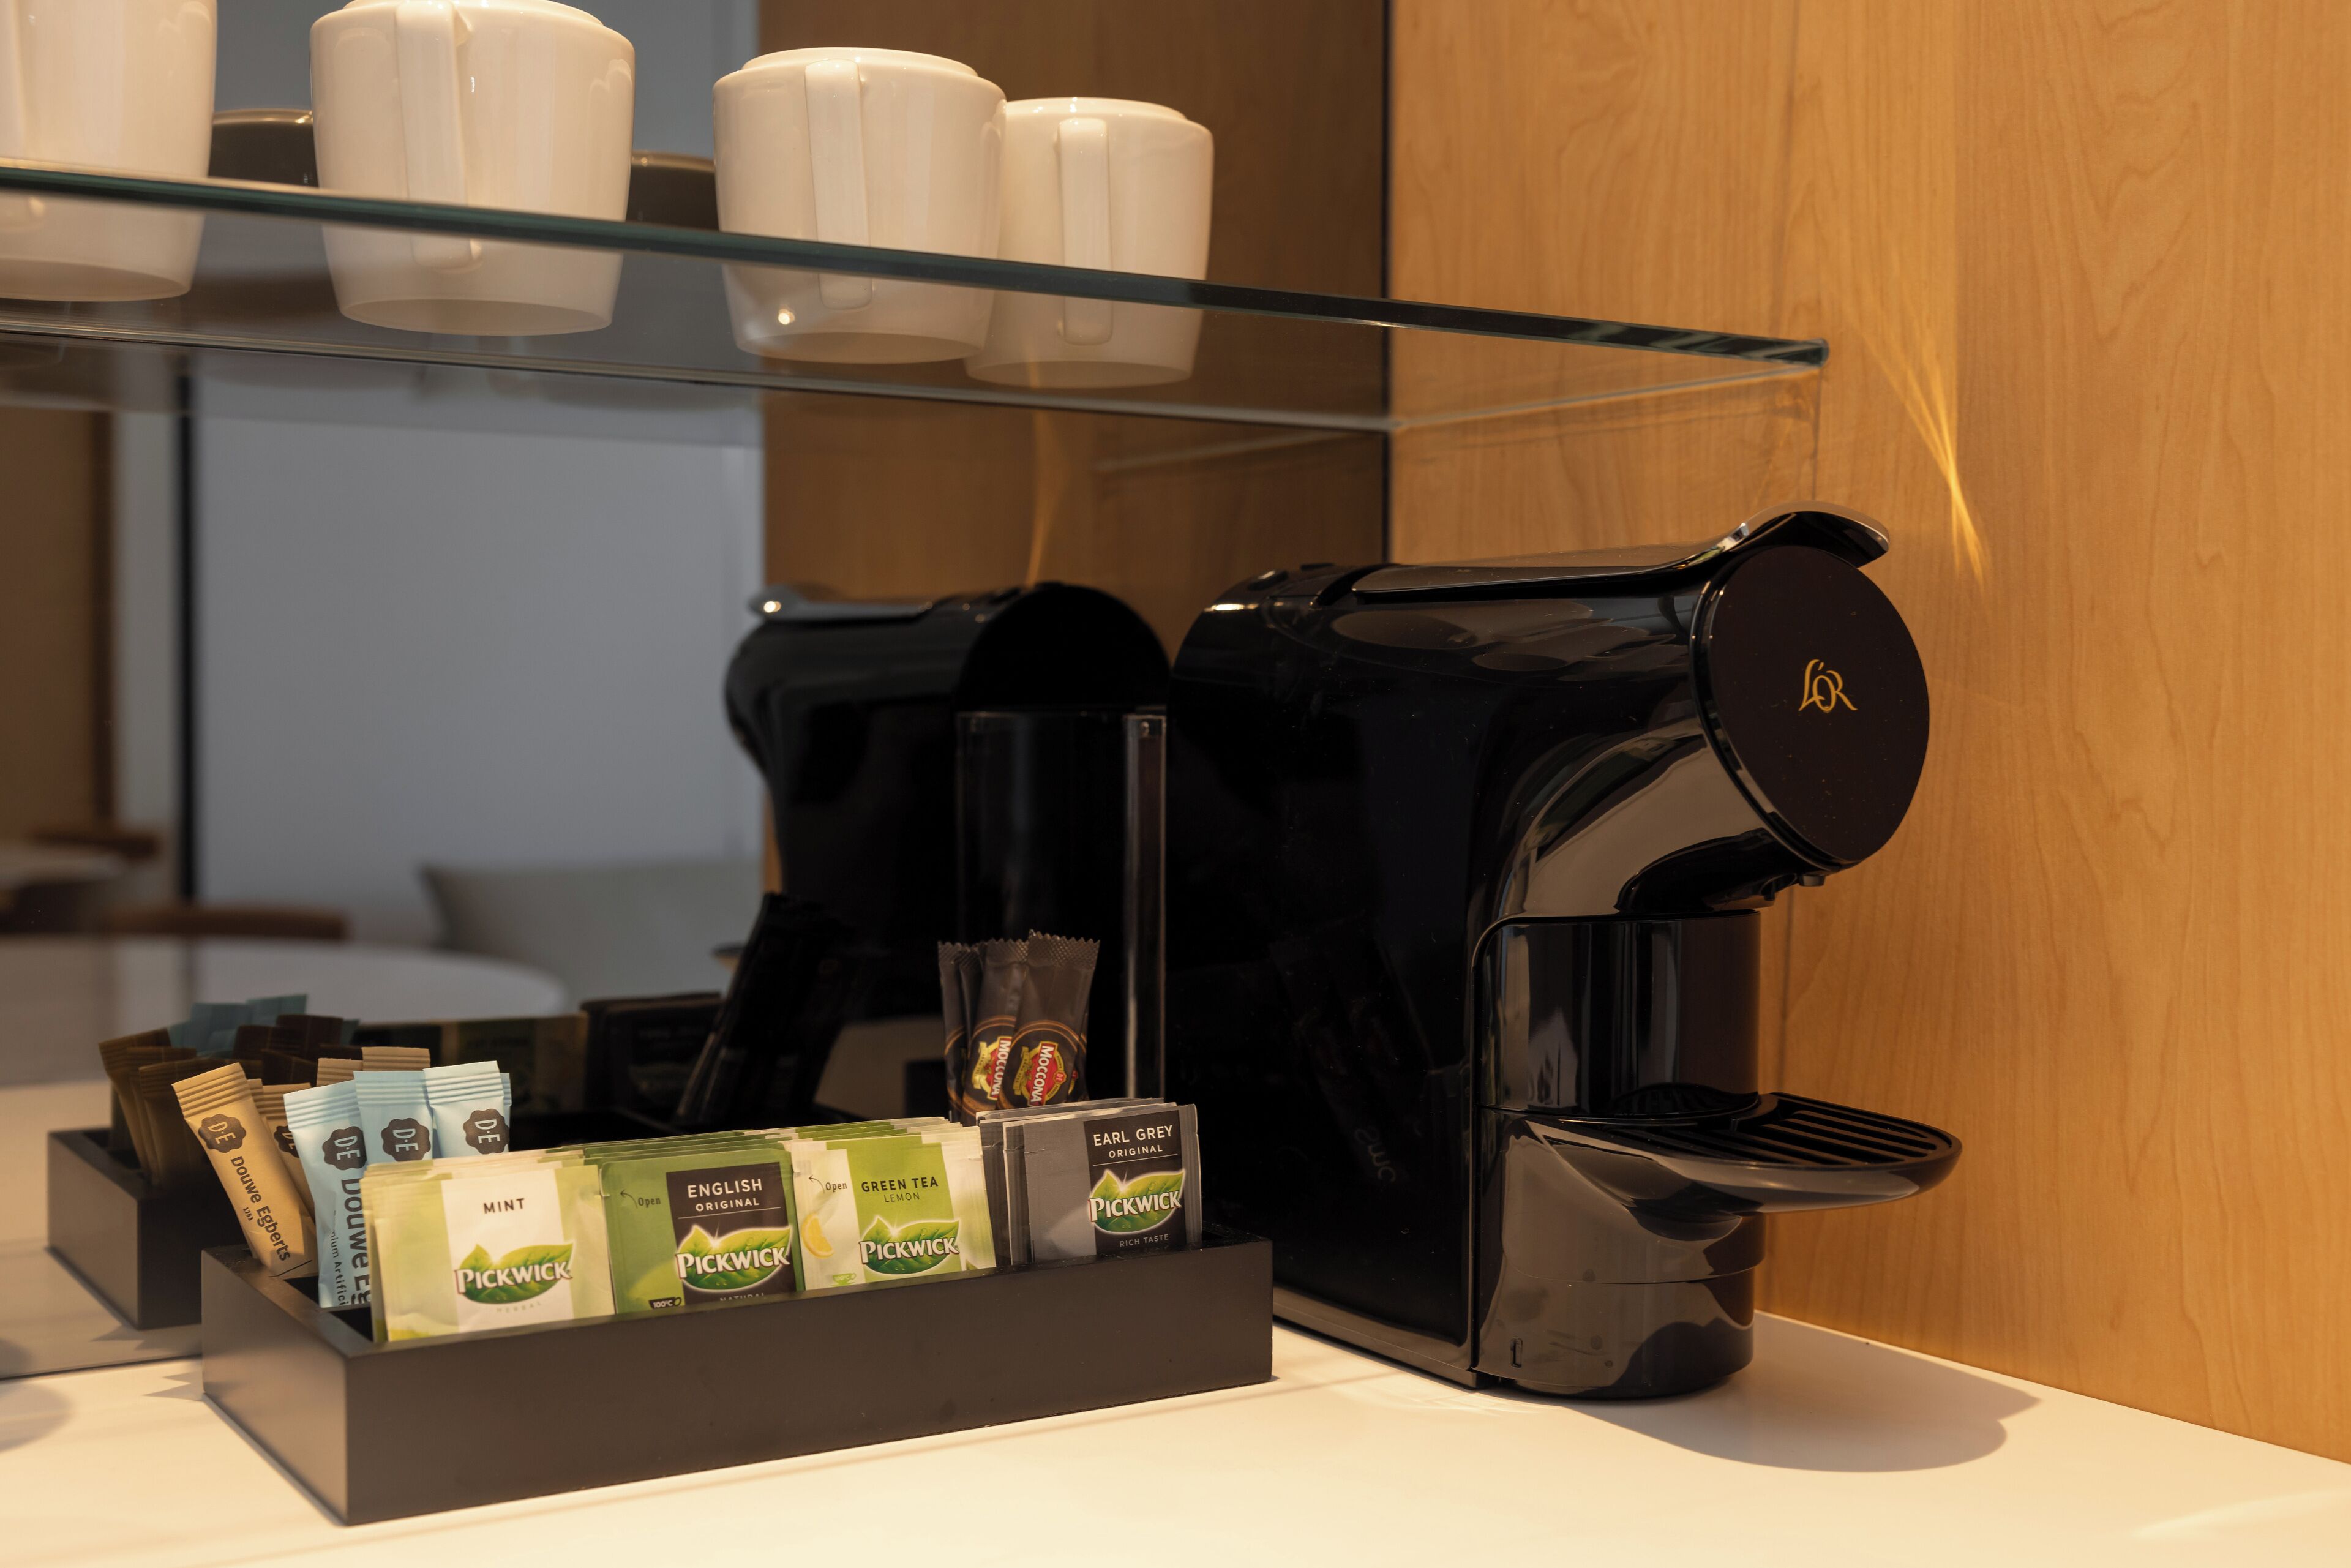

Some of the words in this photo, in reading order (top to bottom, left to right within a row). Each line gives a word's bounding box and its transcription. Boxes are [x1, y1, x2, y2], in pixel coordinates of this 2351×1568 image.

[1031, 1046, 1055, 1102] MOCCONA
[1093, 1131, 1130, 1147] EARL
[1136, 1125, 1173, 1141] GREY
[1108, 1144, 1163, 1158] ORIGINAL
[688, 1178, 763, 1199] ENGLISH
[826, 1182, 848, 1193] Open
[861, 1179, 907, 1193] GREEN
[911, 1176, 939, 1188] TEA
[638, 1196, 661, 1209] Open
[695, 1198, 760, 1212] ORIGINAL
[883, 1191, 920, 1202] LEMON
[230, 1156, 262, 1204] Douwe
[256, 1206, 290, 1261] Egberts
[483, 1198, 525, 1215] MINT
[1088, 1190, 1182, 1223] PICKWICK
[859, 1237, 960, 1264] PICKWICK
[1119, 1238, 1140, 1248] RICH
[1143, 1234, 1169, 1244] TASTE
[675, 1247, 790, 1279] PICKWICK
[454, 1261, 572, 1294] PICKWICK
